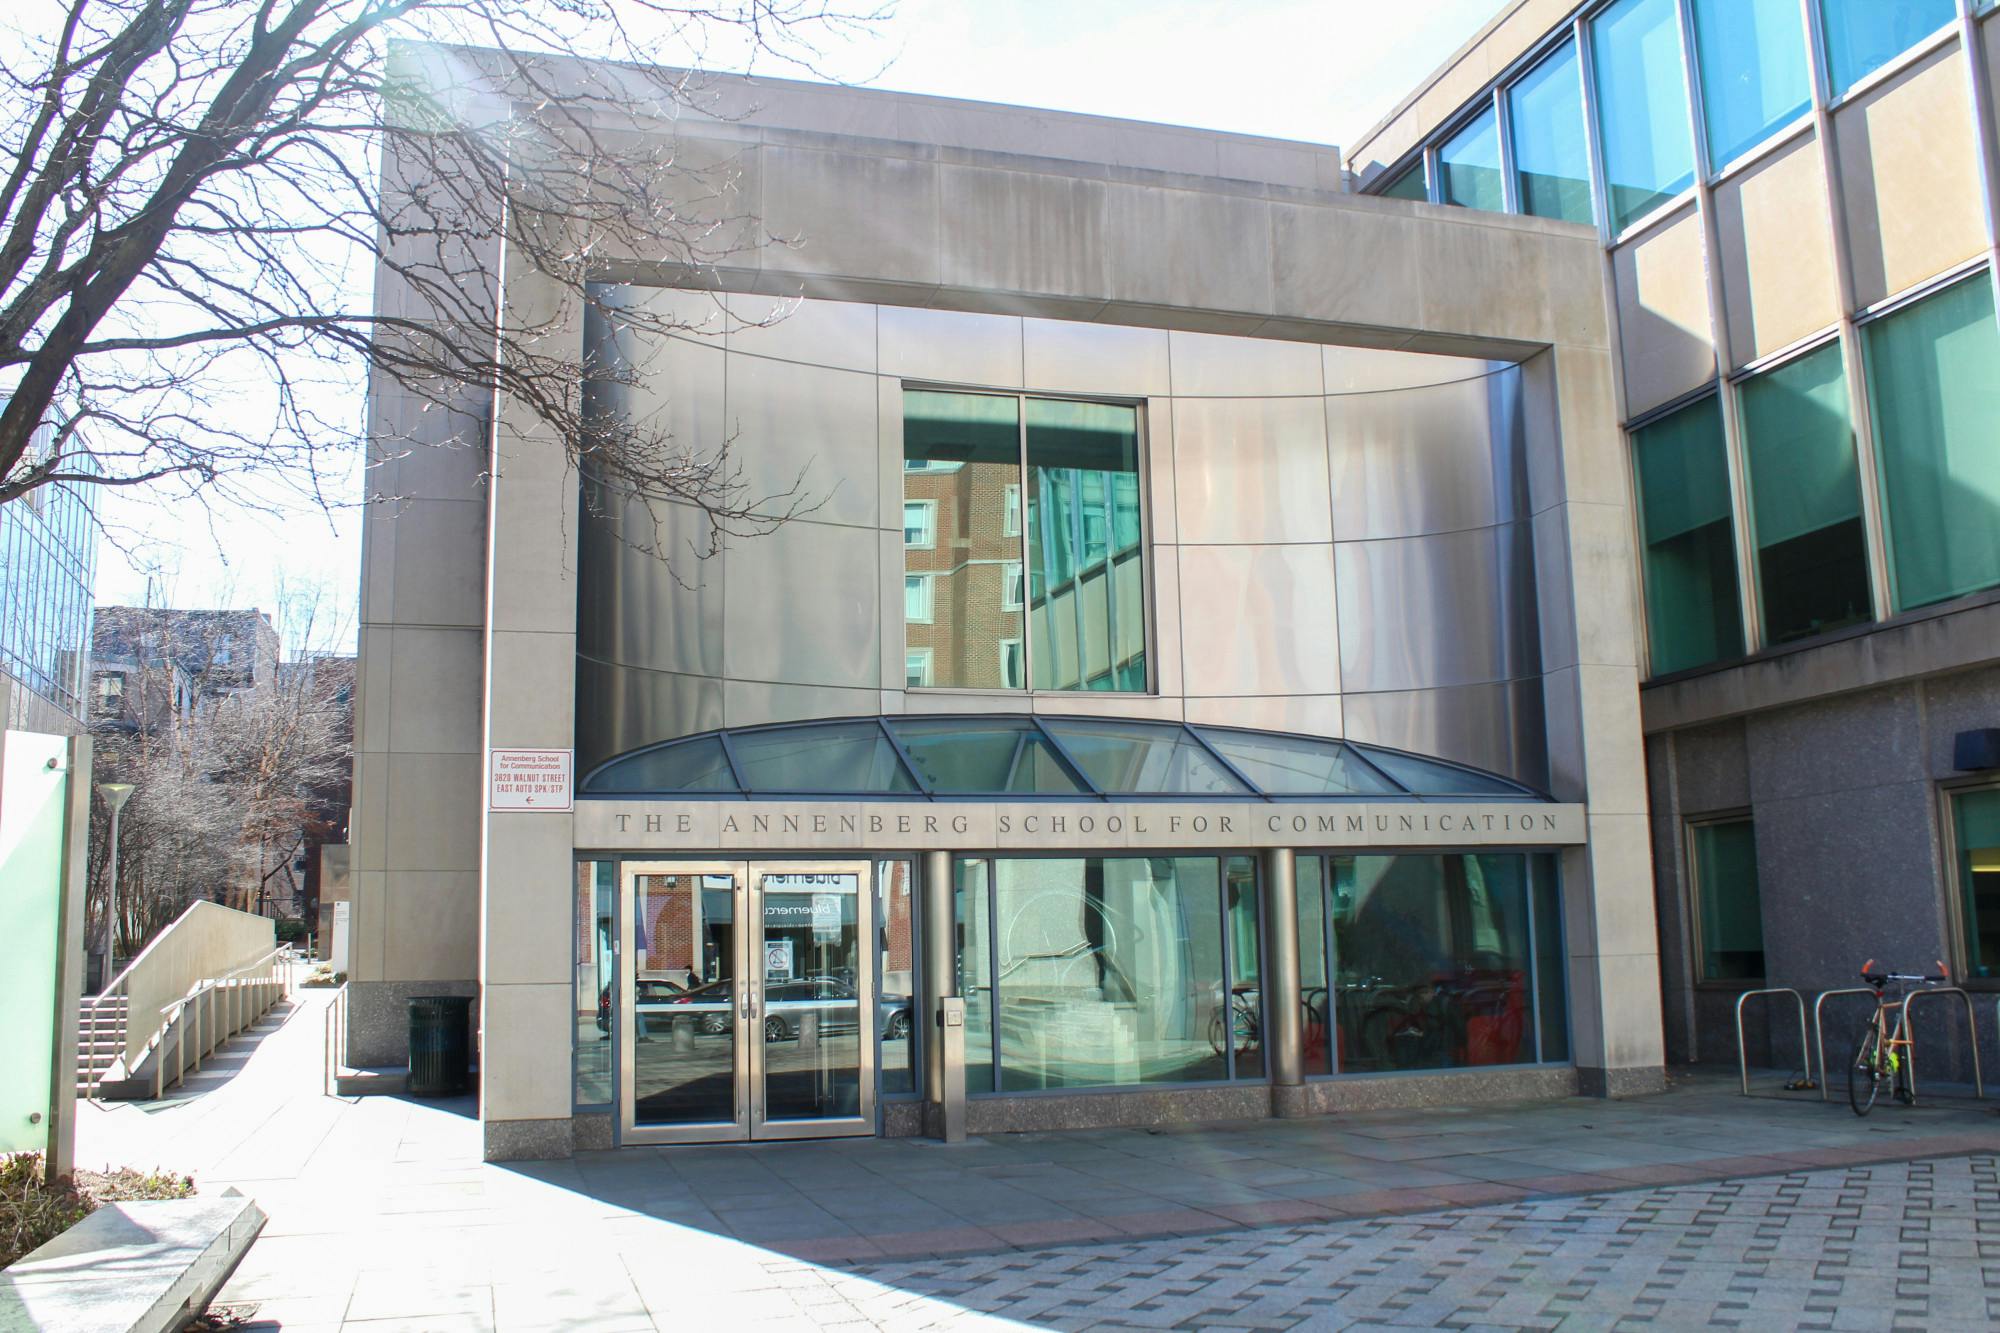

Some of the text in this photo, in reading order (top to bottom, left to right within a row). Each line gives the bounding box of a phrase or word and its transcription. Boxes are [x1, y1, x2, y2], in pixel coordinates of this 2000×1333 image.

[501, 755, 536, 763] Annenberg
[513, 773, 540, 782] WALNUT
[542, 774, 566, 782] STREET
[496, 784, 513, 792] EAST
[515, 784, 532, 793] AUTO
[615, 814, 1557, 833] THE ANNENBERG SCHOOL FOR COMMUNICATION
